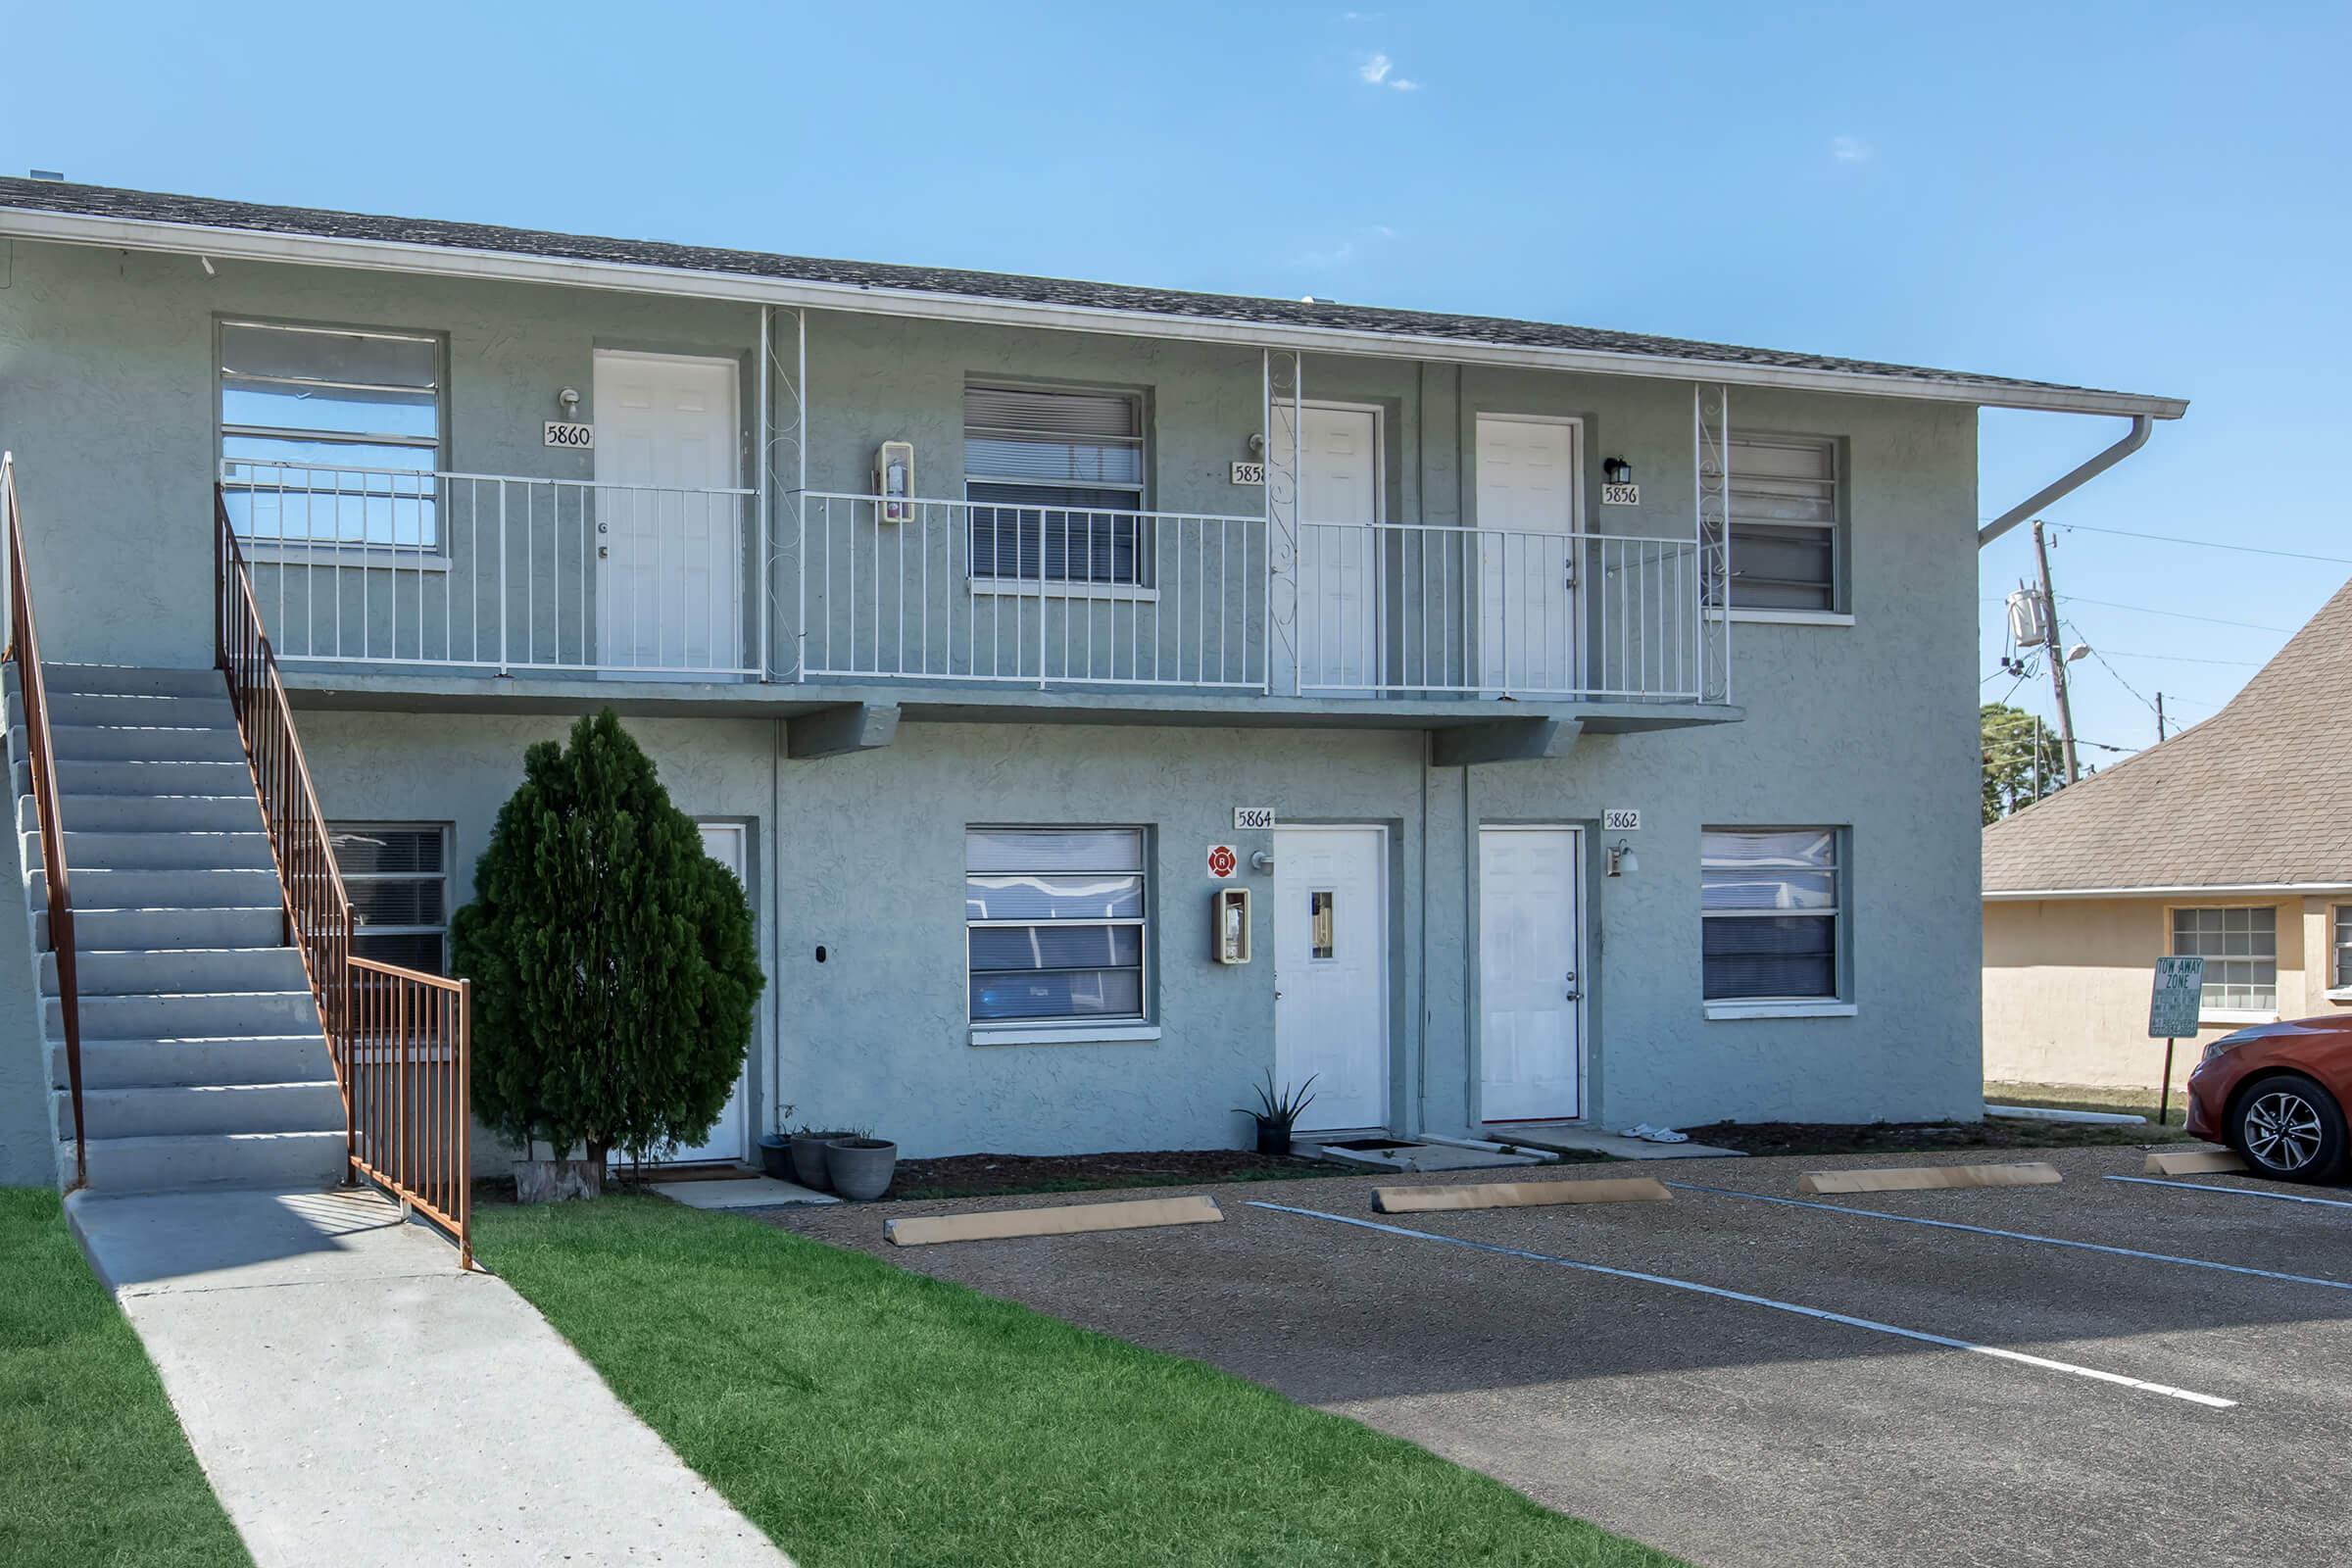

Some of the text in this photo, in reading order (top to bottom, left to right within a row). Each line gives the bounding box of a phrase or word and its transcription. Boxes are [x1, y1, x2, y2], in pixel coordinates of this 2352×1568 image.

[547, 425, 590, 445] 5860
[1606, 487, 1637, 503] 5856
[1239, 809, 1271, 827] 5864
[1607, 812, 1638, 828] 5862
[1219, 858, 1225, 866] R
[2157, 959, 2202, 974] TOW AWAY
[2166, 974, 2189, 989] ZONE
